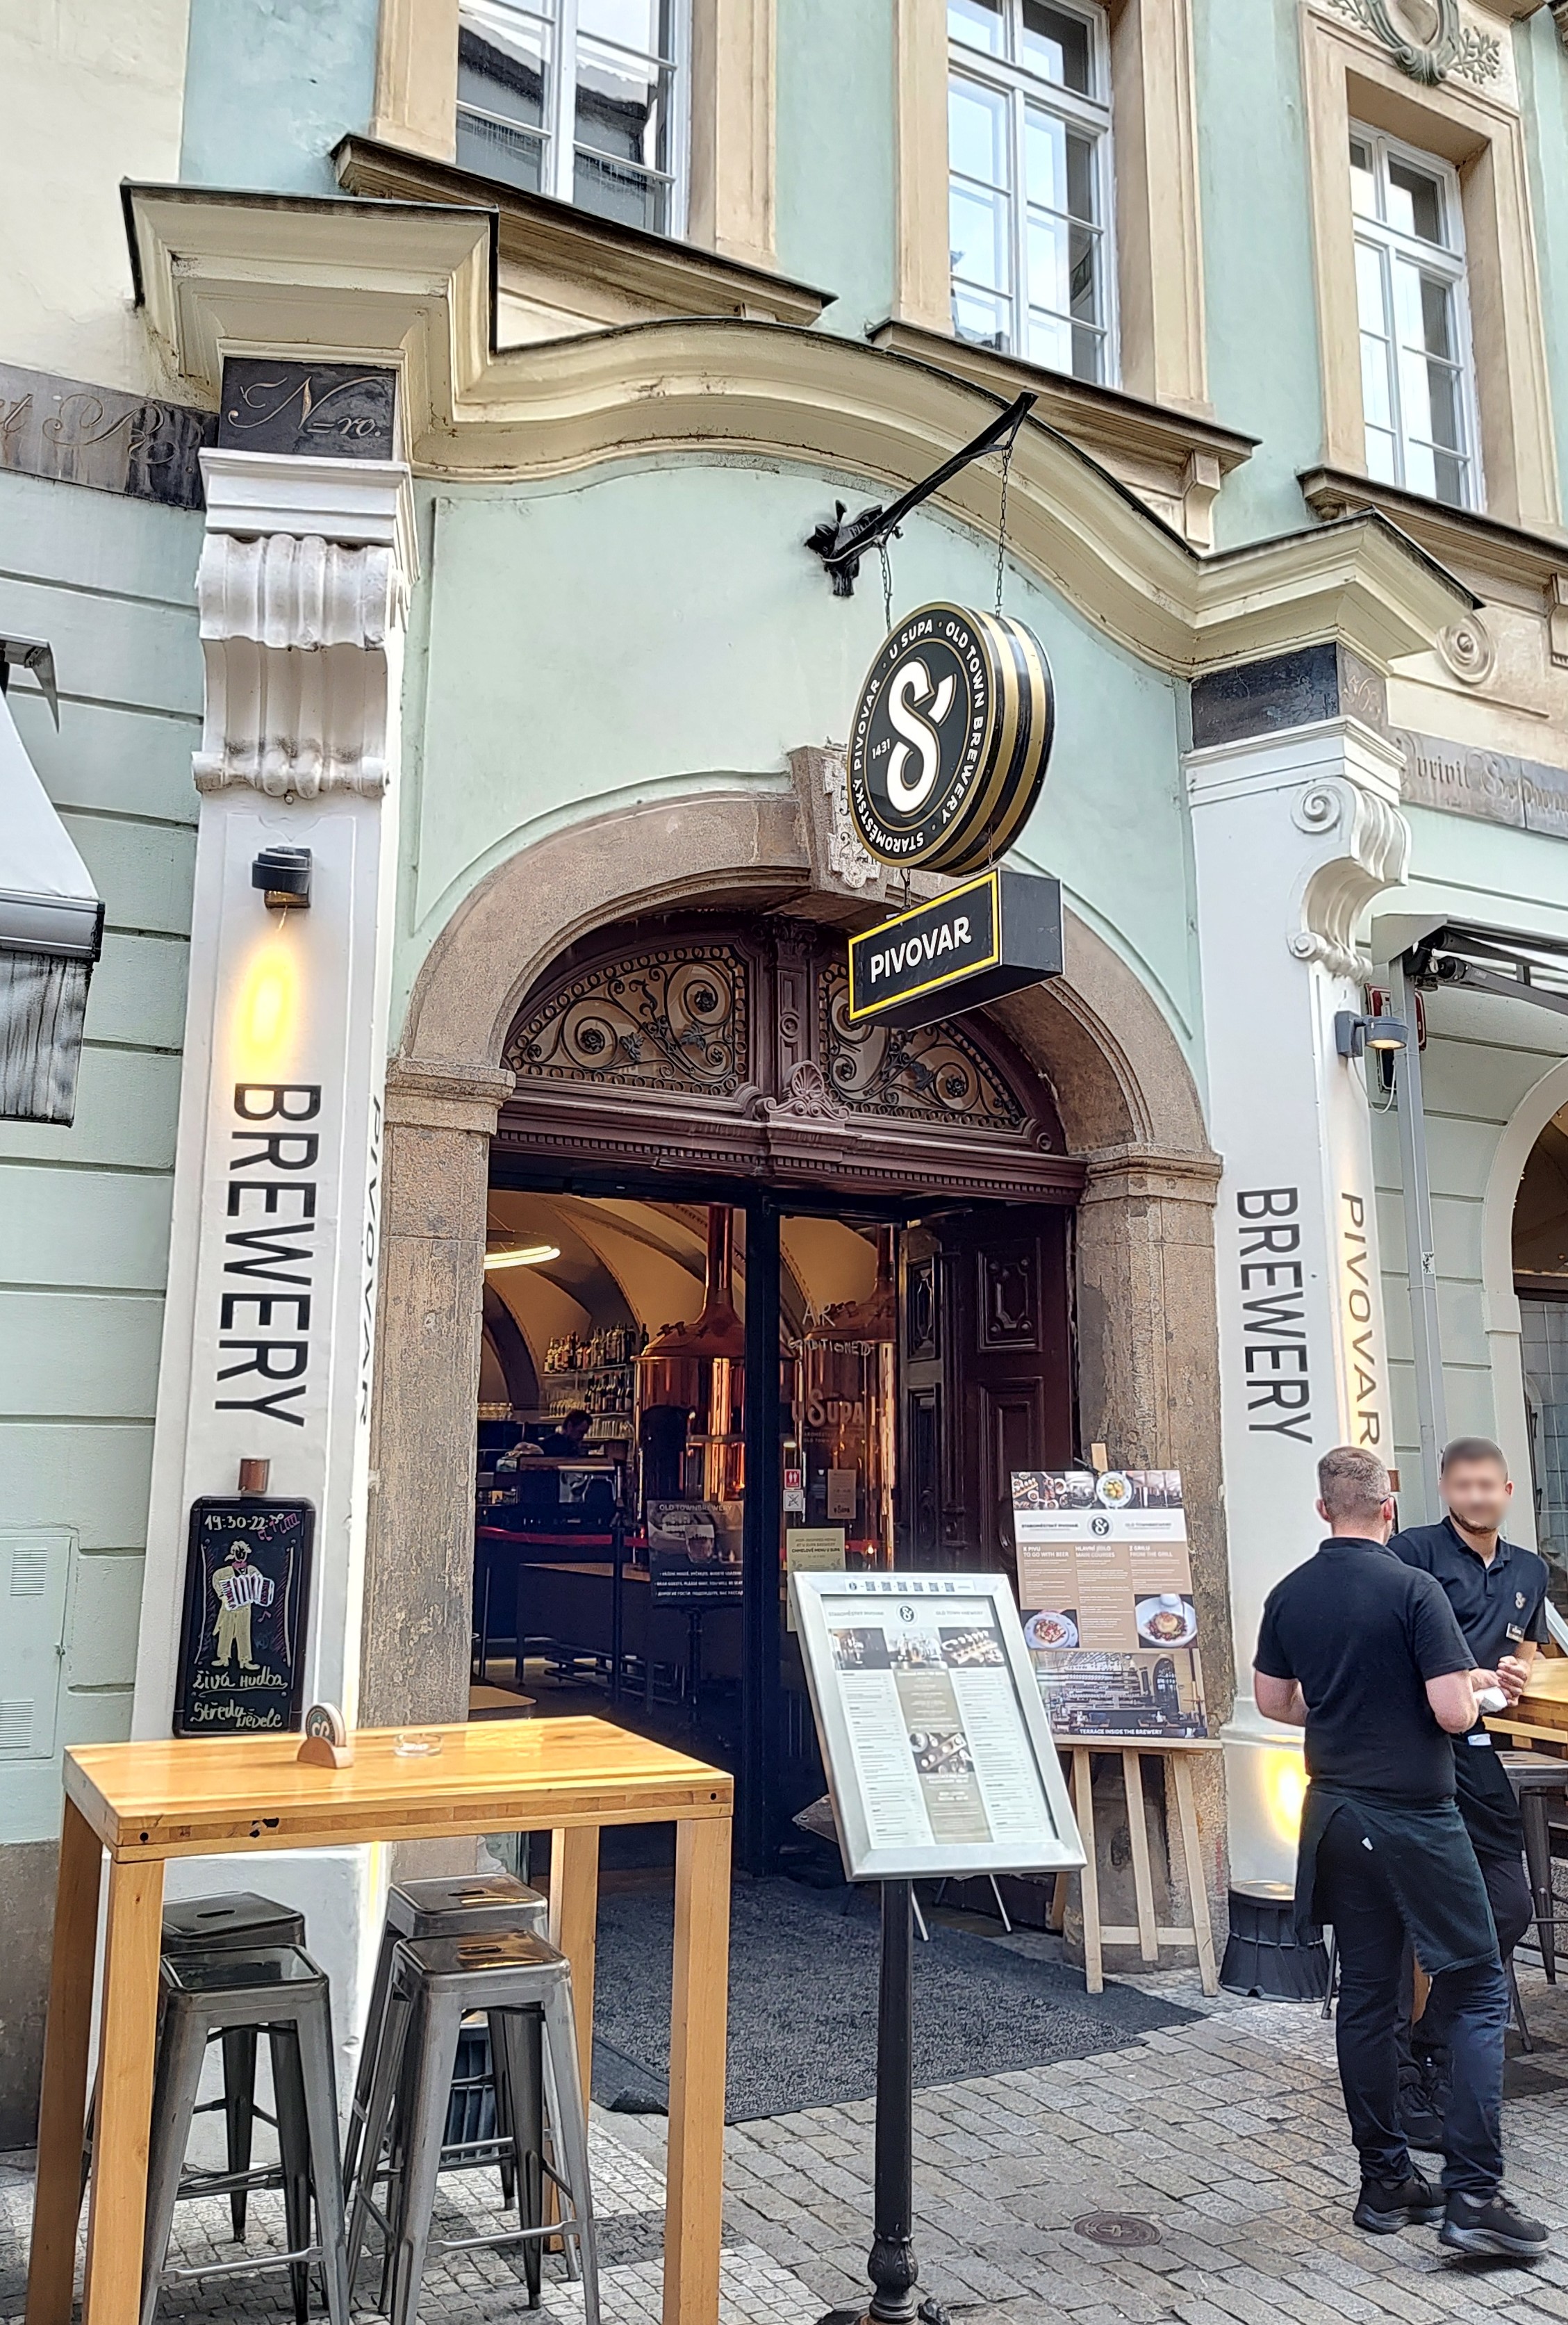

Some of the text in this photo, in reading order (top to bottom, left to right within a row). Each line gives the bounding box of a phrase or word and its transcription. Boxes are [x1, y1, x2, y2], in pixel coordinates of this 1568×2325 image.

[889, 618, 934, 660] U SUPA
[941, 621, 985, 825] OLD TOWN BREWERY
[852, 679, 924, 853] STAROMĚSTSKÝ PIVOVAR
[872, 738, 891, 760] 1431
[870, 916, 973, 984] PIVOVAR
[215, 1083, 322, 1427] BREWERY
[1236, 1187, 1313, 1445] BREWERY
[1341, 1192, 1381, 1445] PIVOVAR
[807, 1388, 866, 1427] SUPA
